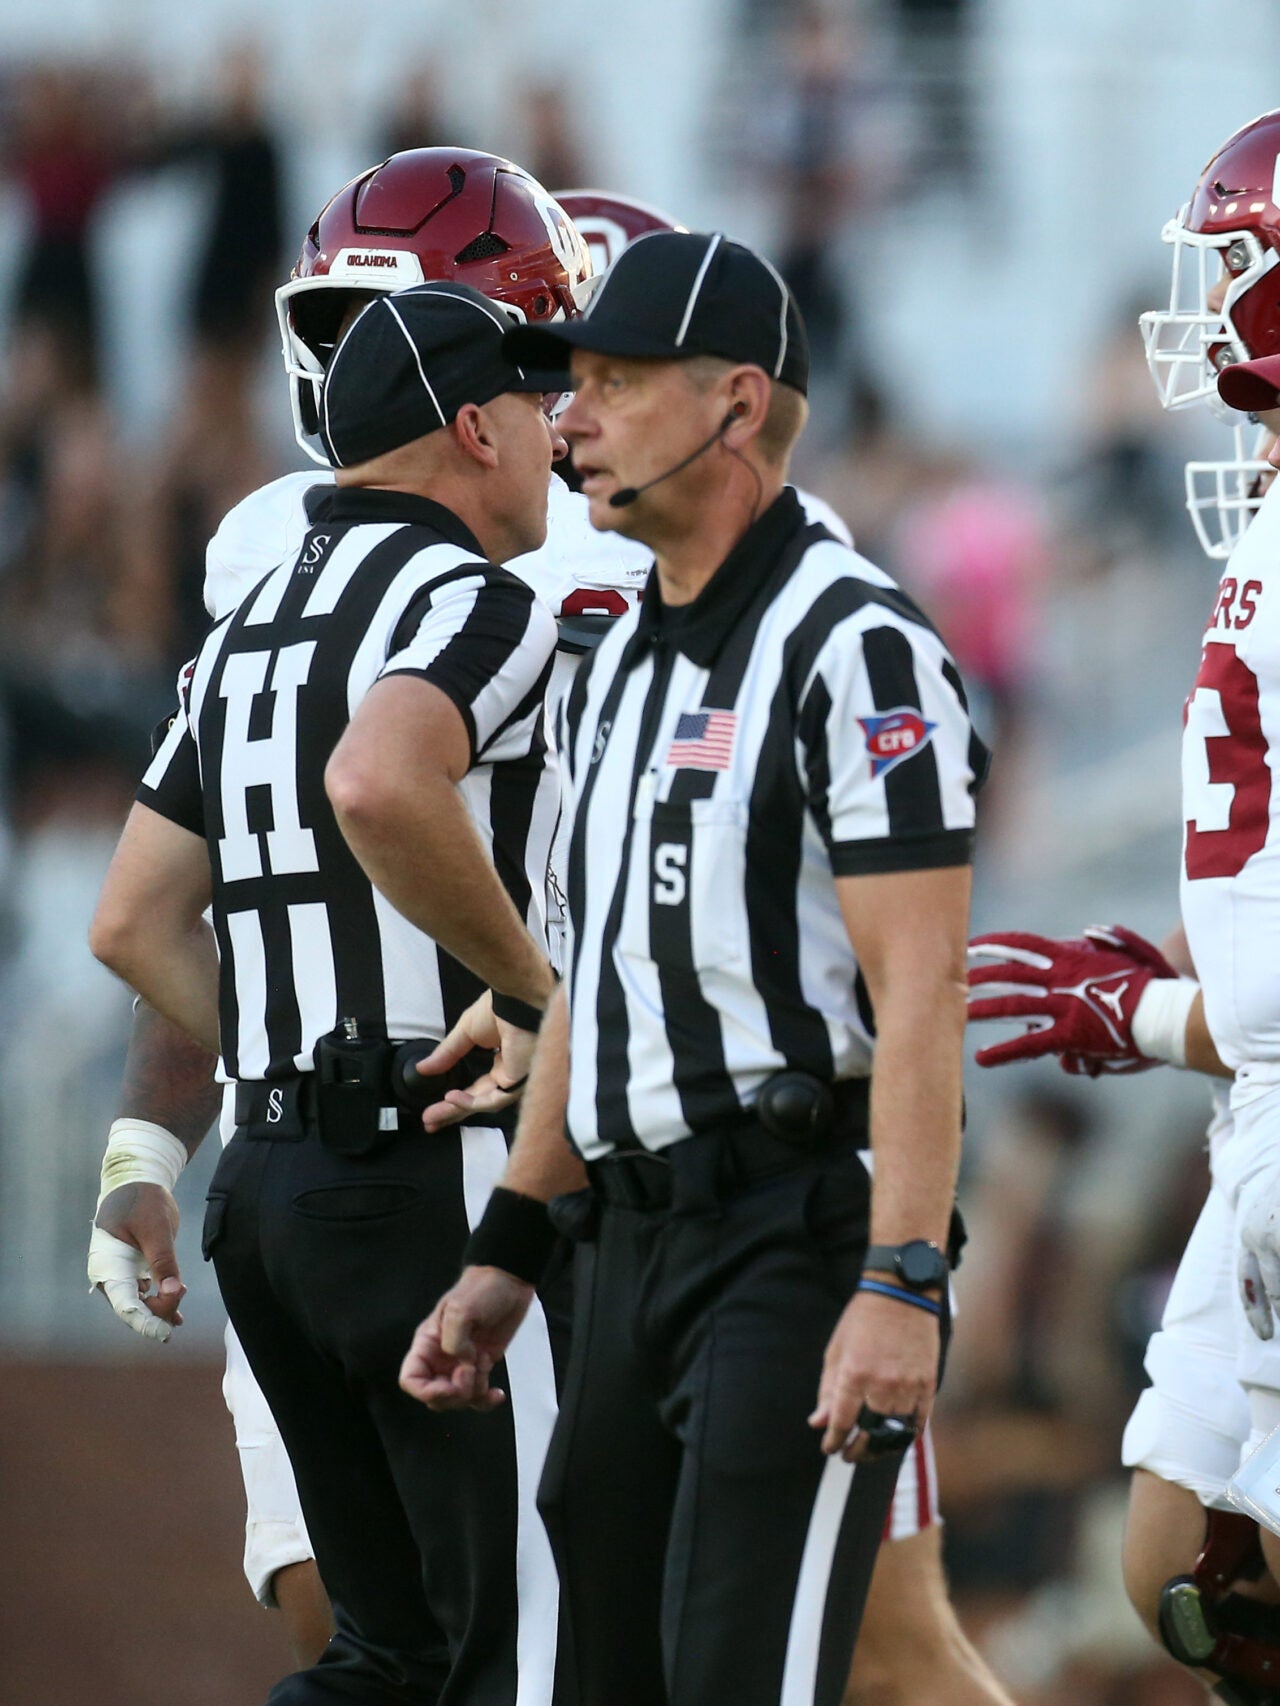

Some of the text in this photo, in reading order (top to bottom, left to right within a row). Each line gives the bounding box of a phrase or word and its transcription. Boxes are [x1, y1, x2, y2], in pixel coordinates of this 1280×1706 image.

[347, 254, 397, 268] OKLAHOMA
[218, 640, 320, 884] H
[655, 842, 687, 906] S
